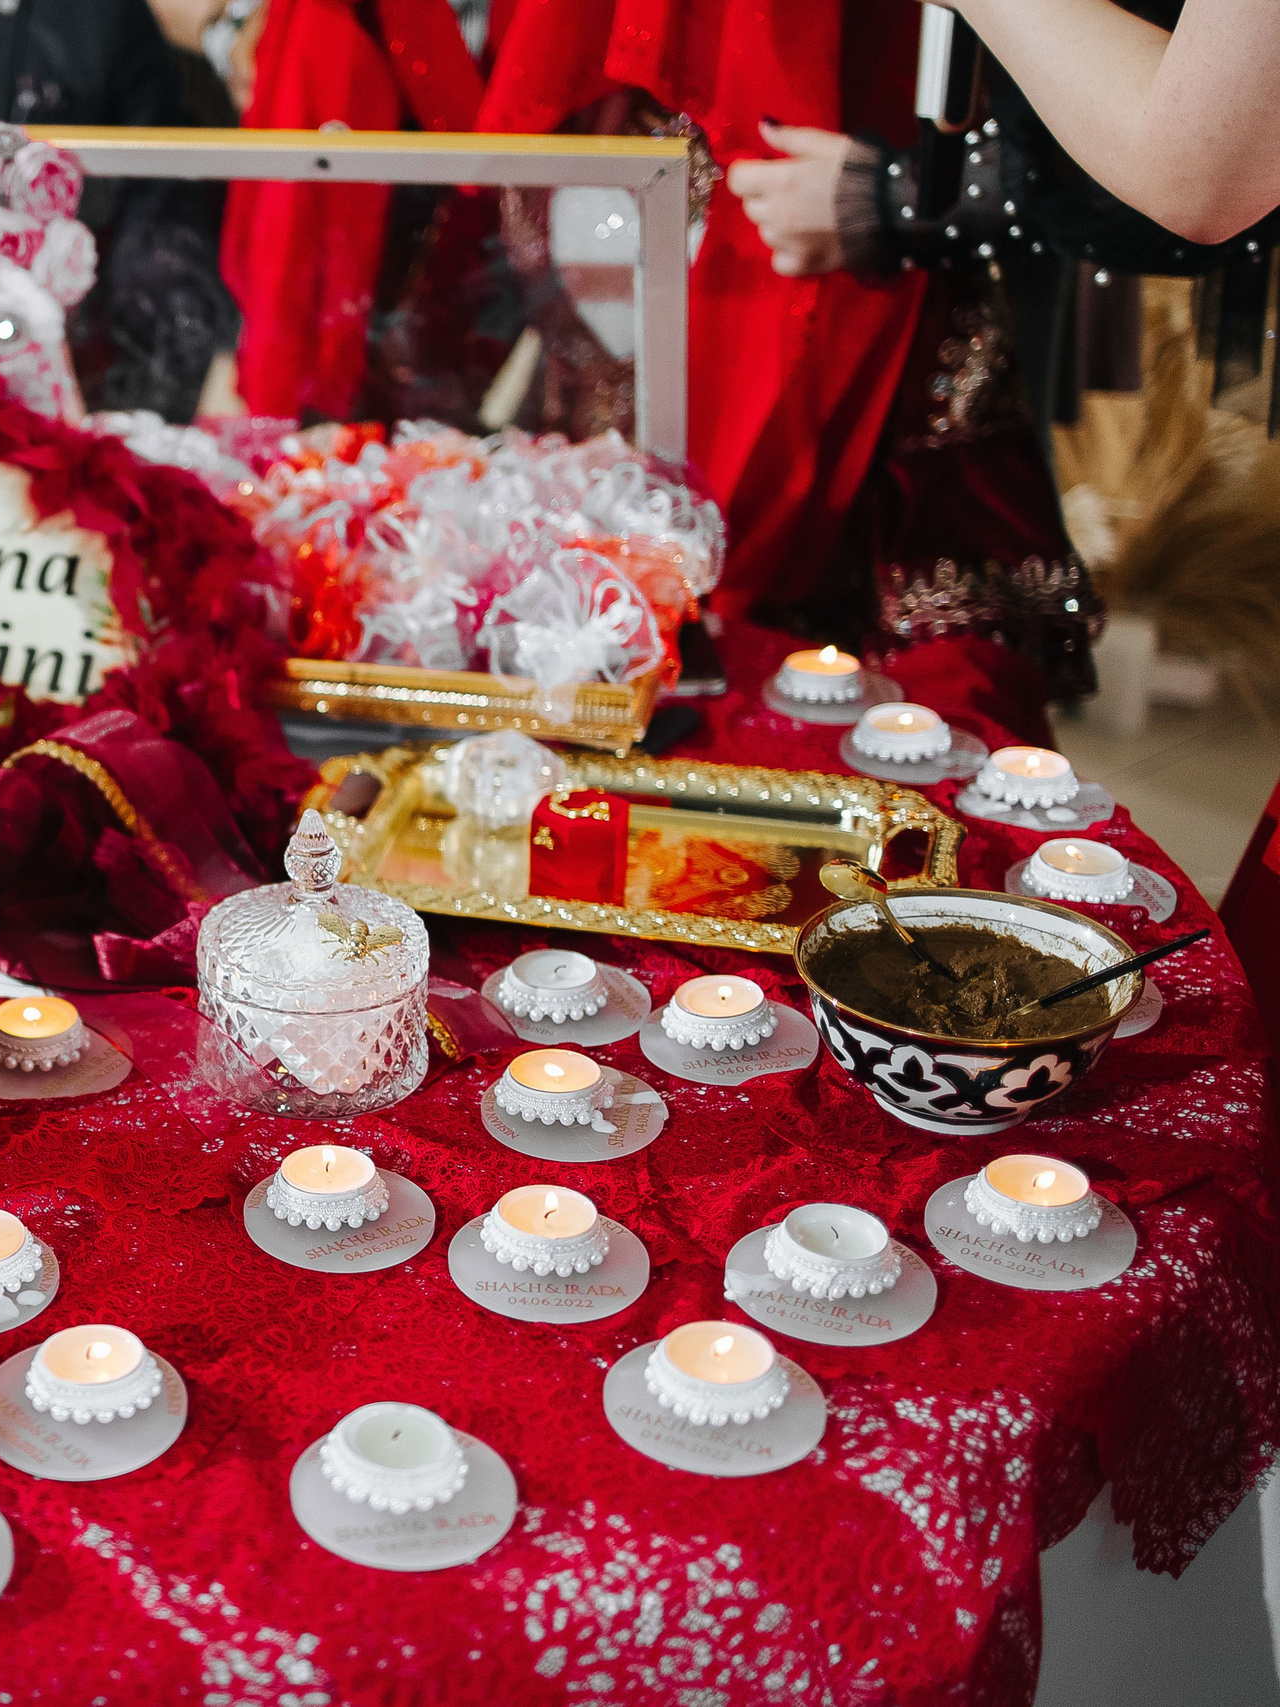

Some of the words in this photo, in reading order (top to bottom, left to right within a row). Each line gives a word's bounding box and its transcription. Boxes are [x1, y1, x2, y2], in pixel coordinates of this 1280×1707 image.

[682, 1054, 739, 1071] SHAKH
[756, 1046, 813, 1061] IRADA
[716, 1061, 792, 1076] 04.06.2022
[635, 1103, 652, 1134] 04.06.20
[305, 1234, 362, 1260] SHAKH
[378, 1215, 432, 1237] IRADA
[344, 1234, 417, 1262] 04.06.2022
[935, 1225, 1005, 1252] SHAKH
[1023, 1252, 1086, 1279] IRADA
[960, 1247, 1046, 1279] 04.06.2022
[475, 1281, 542, 1294] SHAKH
[564, 1284, 628, 1297] IRADA
[508, 1296, 594, 1308] 04.06.2022
[748, 1289, 809, 1311] HAKH
[830, 1306, 892, 1331] IRADA
